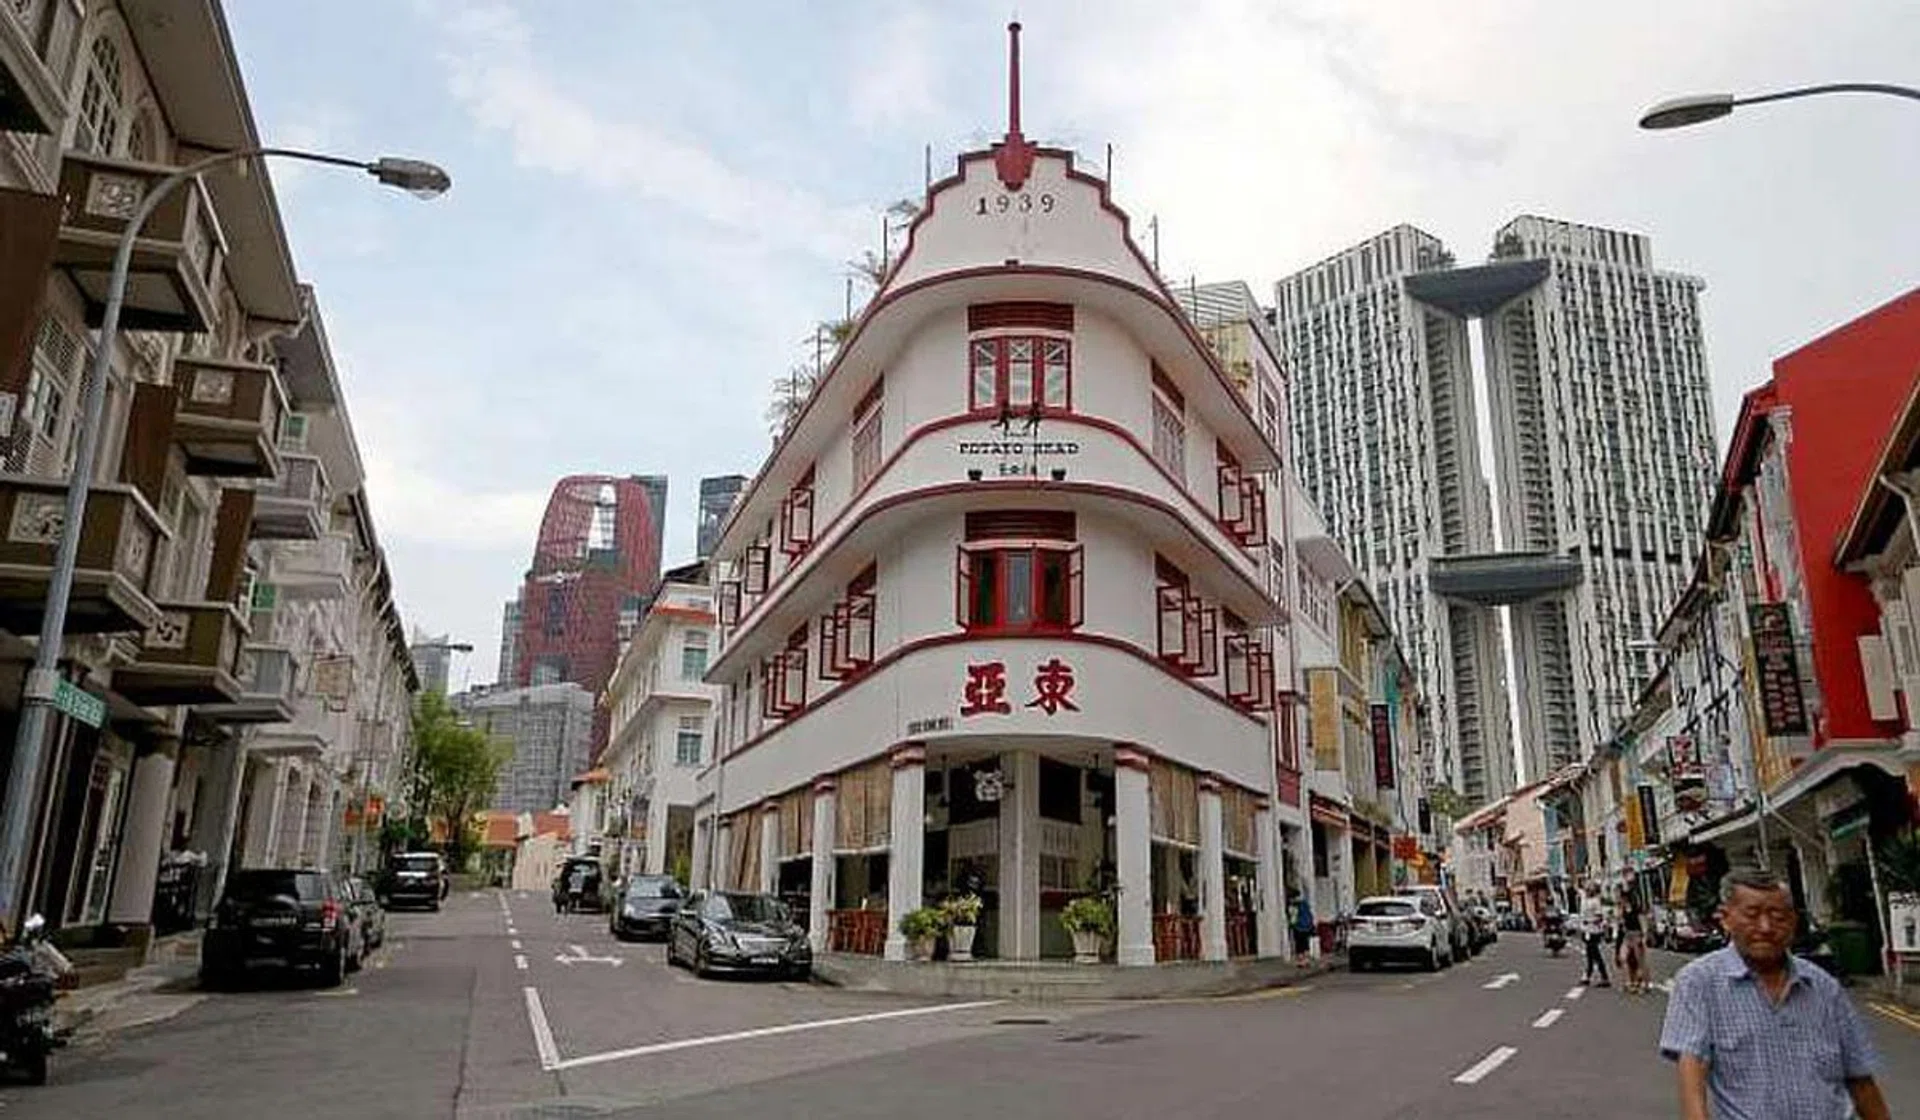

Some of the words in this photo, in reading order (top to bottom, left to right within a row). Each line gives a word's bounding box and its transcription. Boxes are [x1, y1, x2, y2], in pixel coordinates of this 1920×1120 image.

[976, 193, 1054, 215] 1939
[960, 442, 1024, 454] POTATO
[1034, 442, 1079, 454] HEAD
